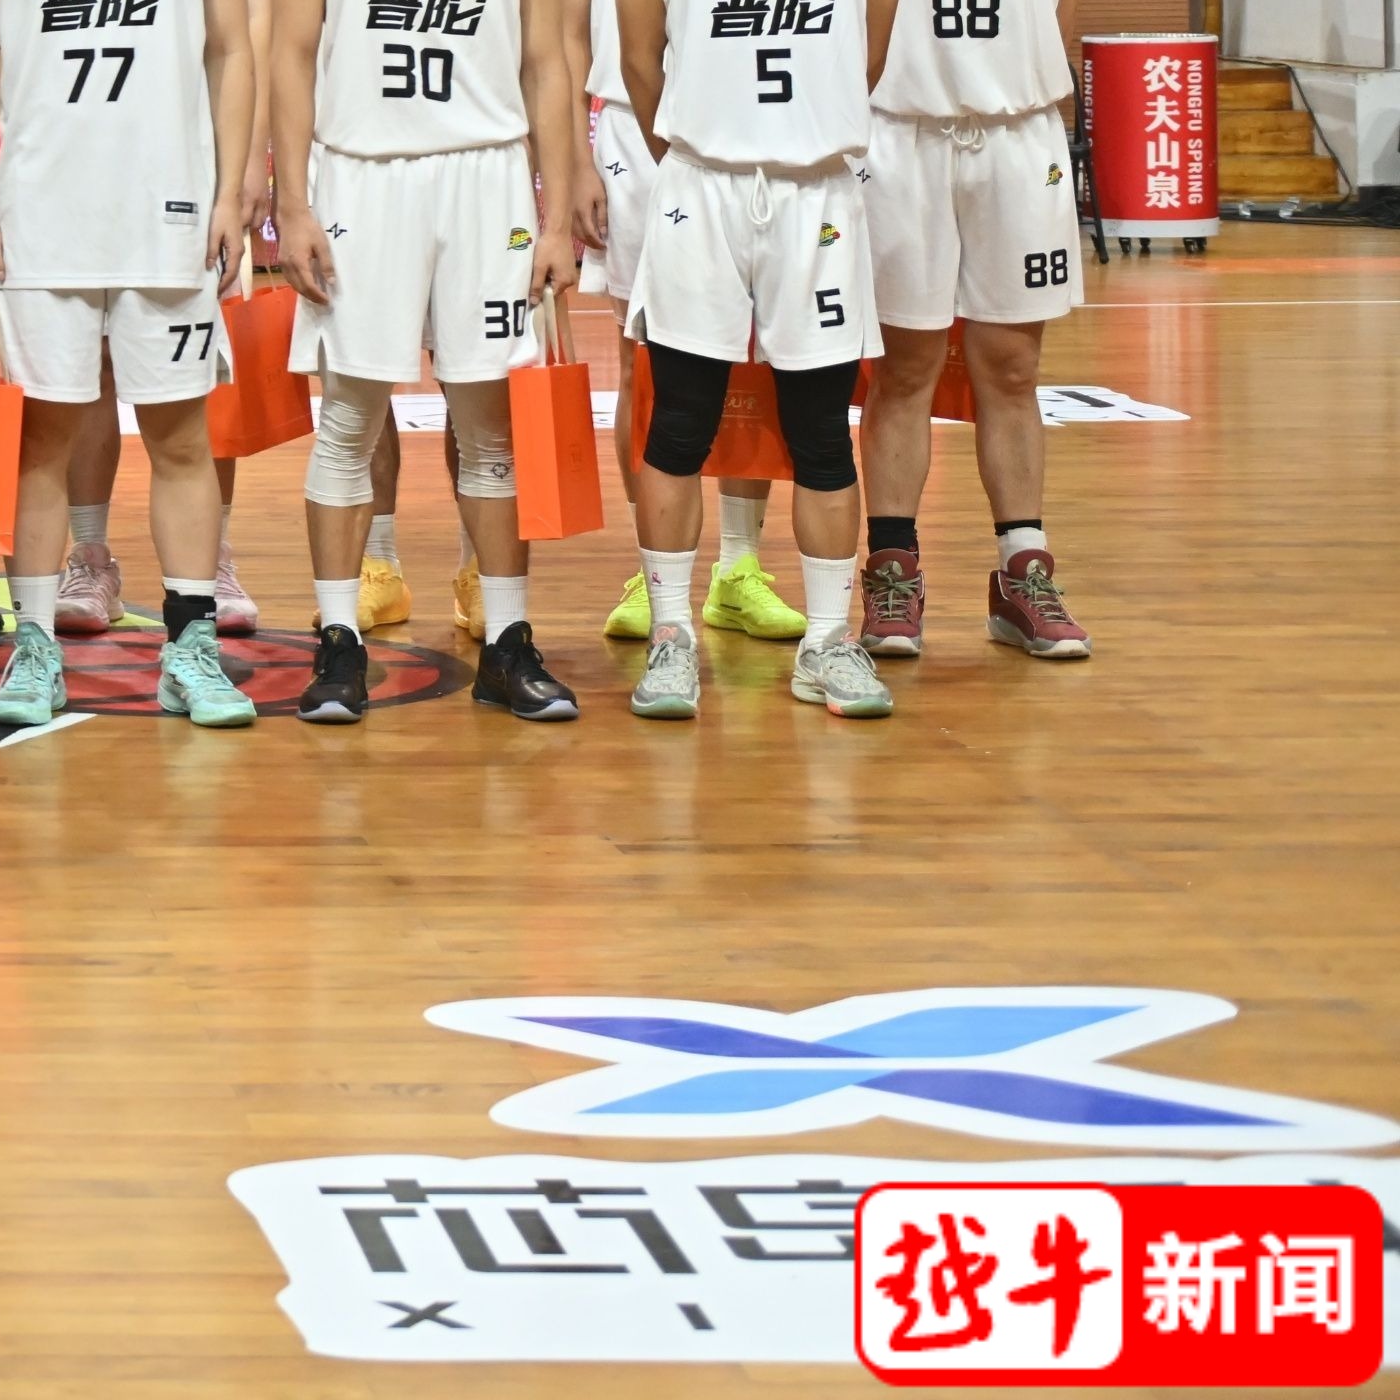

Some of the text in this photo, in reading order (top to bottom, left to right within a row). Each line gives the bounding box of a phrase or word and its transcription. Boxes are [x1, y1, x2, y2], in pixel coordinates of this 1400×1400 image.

[63, 47, 135, 103] 77
[382, 43, 454, 102] 30
[756, 48, 793, 103] 5
[1143, 56, 1183, 208] 农夫山泉
[1187, 59, 1204, 205] NONGFU SPRING
[1024, 248, 1068, 288] 88
[484, 299, 527, 338] 30
[815, 288, 845, 328] 5
[169, 322, 214, 361] 77
